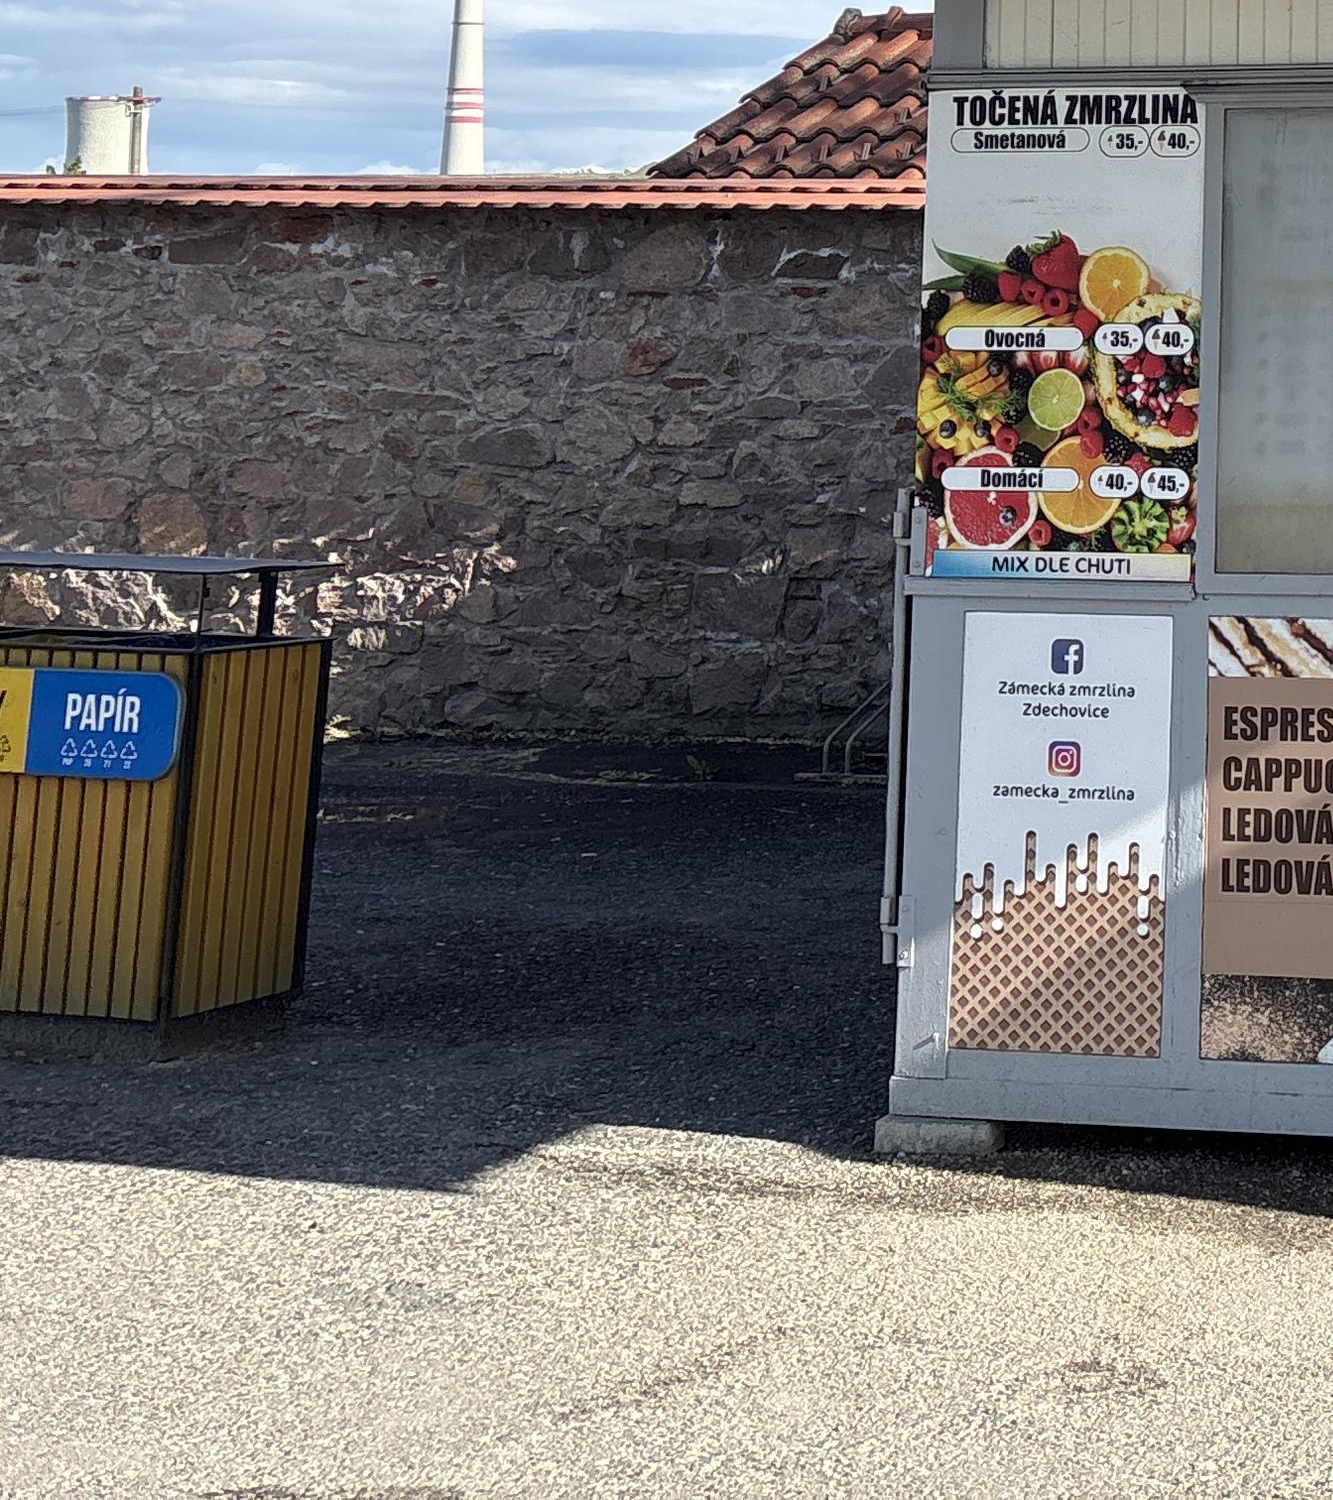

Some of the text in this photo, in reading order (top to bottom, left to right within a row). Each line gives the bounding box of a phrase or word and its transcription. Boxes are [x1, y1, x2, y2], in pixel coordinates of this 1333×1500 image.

[953, 90, 1198, 127] TOČENÁ ZMRZLINA
[974, 130, 1195, 151] Smetanová 35,- 40,-
[984, 329, 1190, 350] Ovocná 35,- 40,-
[980, 470, 1185, 493] Domácí 40,- 45,-
[991, 557, 1131, 575] MIX DLE CHUTI
[998, 681, 1135, 698] Zámecká zmrzlina
[64, 688, 140, 733] PAPÍR
[1023, 703, 1109, 718] Zdechovice
[1222, 804, 1333, 845] LEDOVÁ
[1221, 856, 1333, 896] LEDOVÁ
